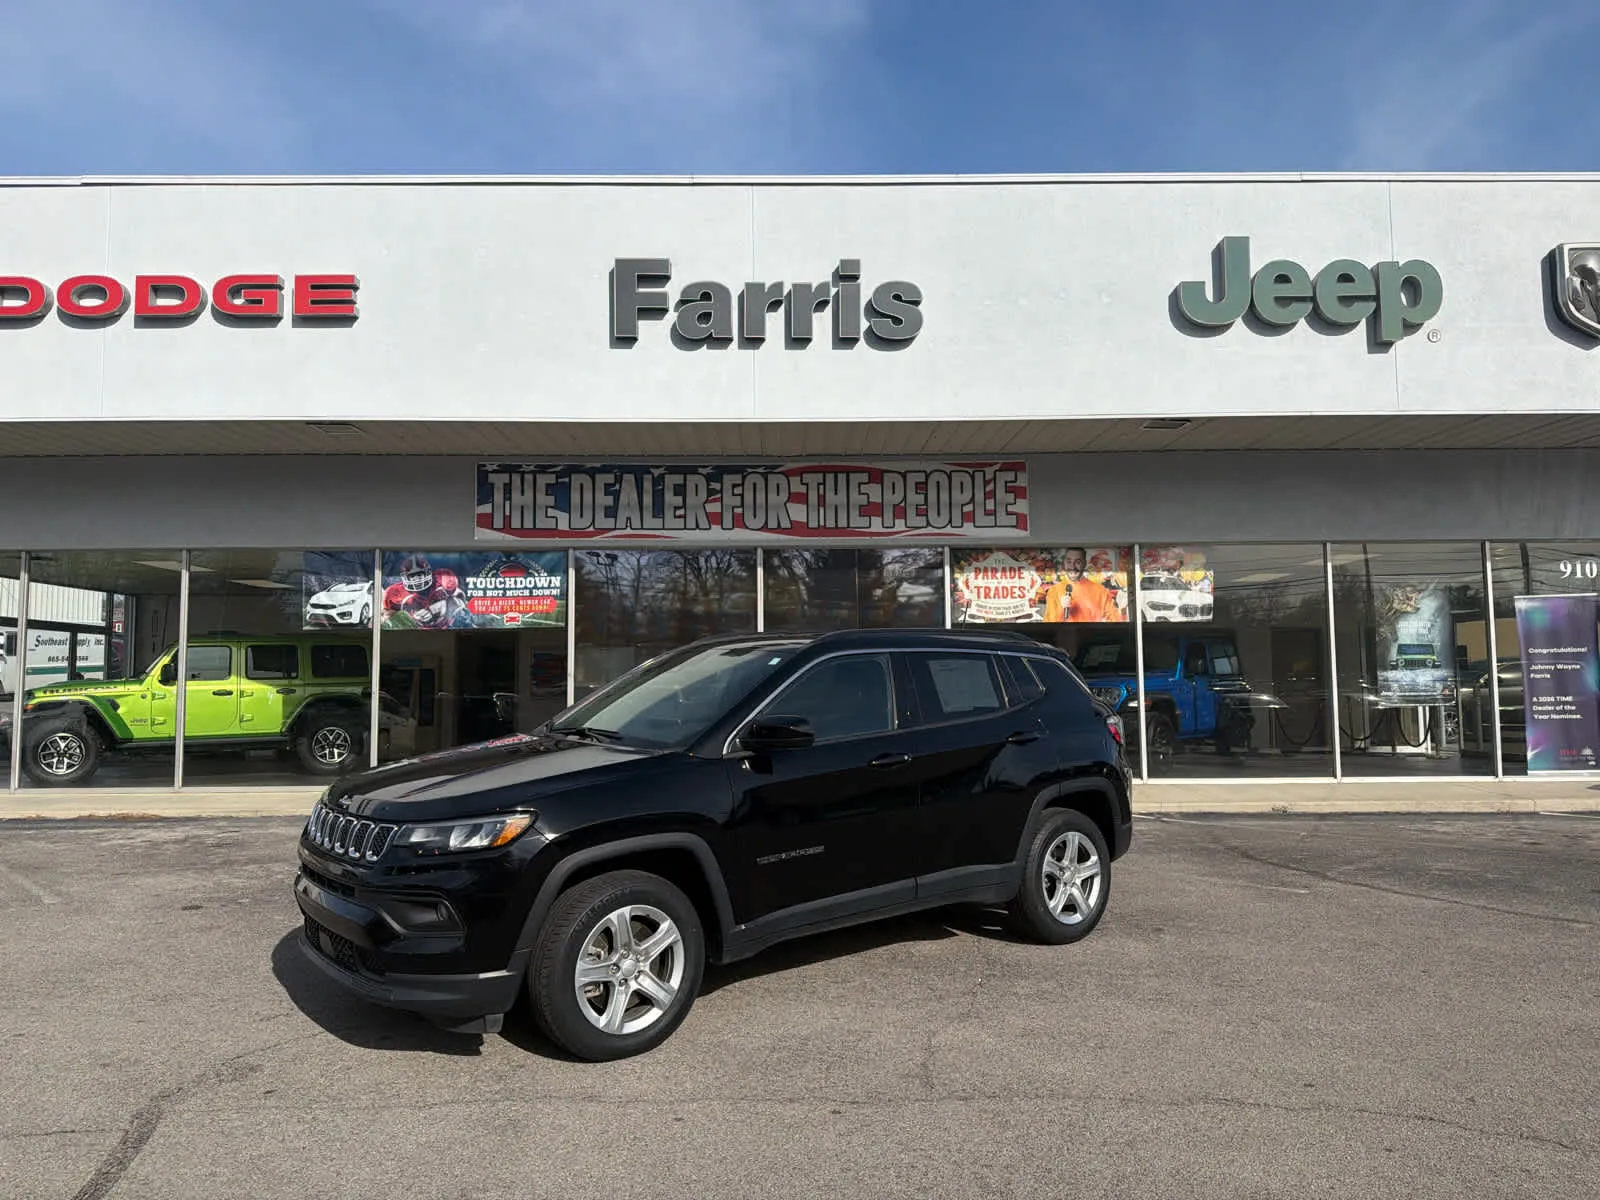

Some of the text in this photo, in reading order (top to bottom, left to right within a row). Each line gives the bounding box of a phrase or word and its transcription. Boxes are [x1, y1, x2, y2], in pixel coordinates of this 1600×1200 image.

[1177, 235, 1443, 345] Jeep
[611, 257, 924, 345] Farris
[487, 470, 1018, 530] THE DEALER FOR THE PEOPLE
[974, 566, 1025, 580] PARADE
[1559, 560, 1598, 579] 910
[466, 576, 561, 589] TOUCHDOWN
[974, 585, 1026, 600] TRADES
[34, 635, 69, 648] Southeast
[1528, 646, 1588, 654] Congratulations!
[1556, 663, 1581, 671] Wayne
